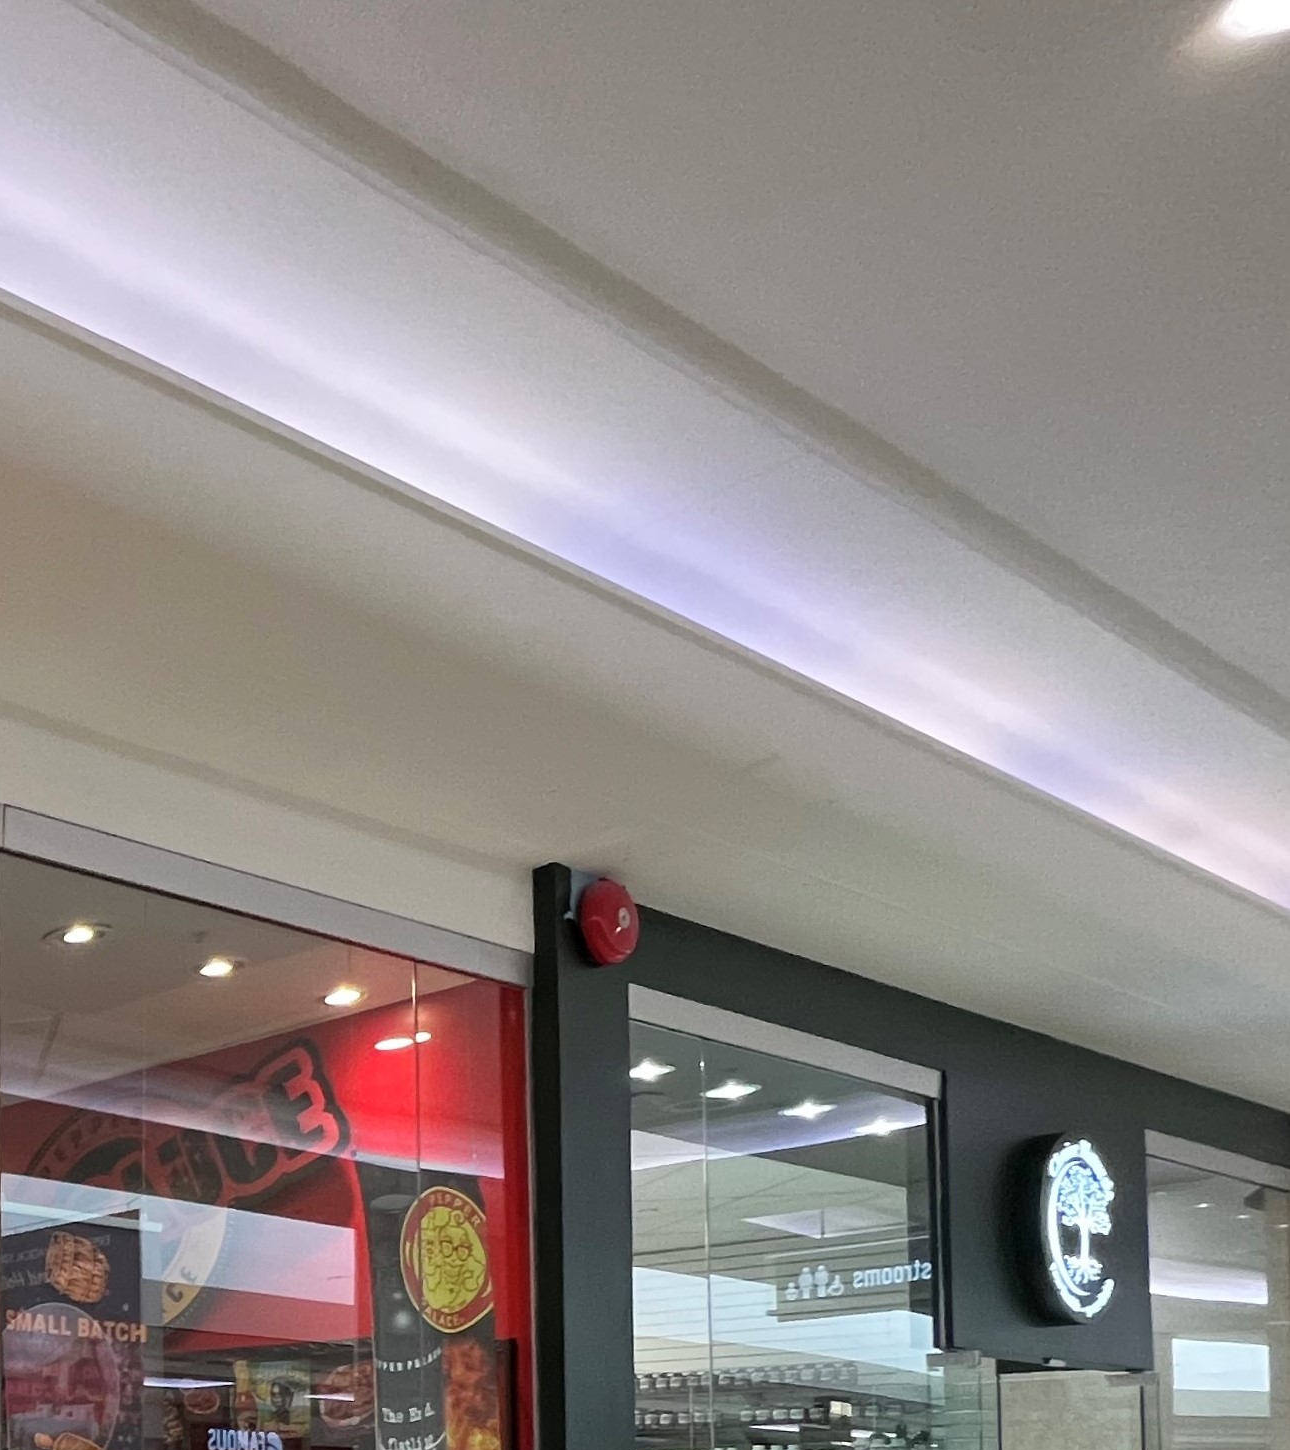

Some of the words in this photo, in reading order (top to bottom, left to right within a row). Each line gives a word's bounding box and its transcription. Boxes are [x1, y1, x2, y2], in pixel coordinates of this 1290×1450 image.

[428, 1193, 482, 1227] PEPPER
[6, 1309, 71, 1336] SMALL
[77, 1317, 148, 1344] BATCH
